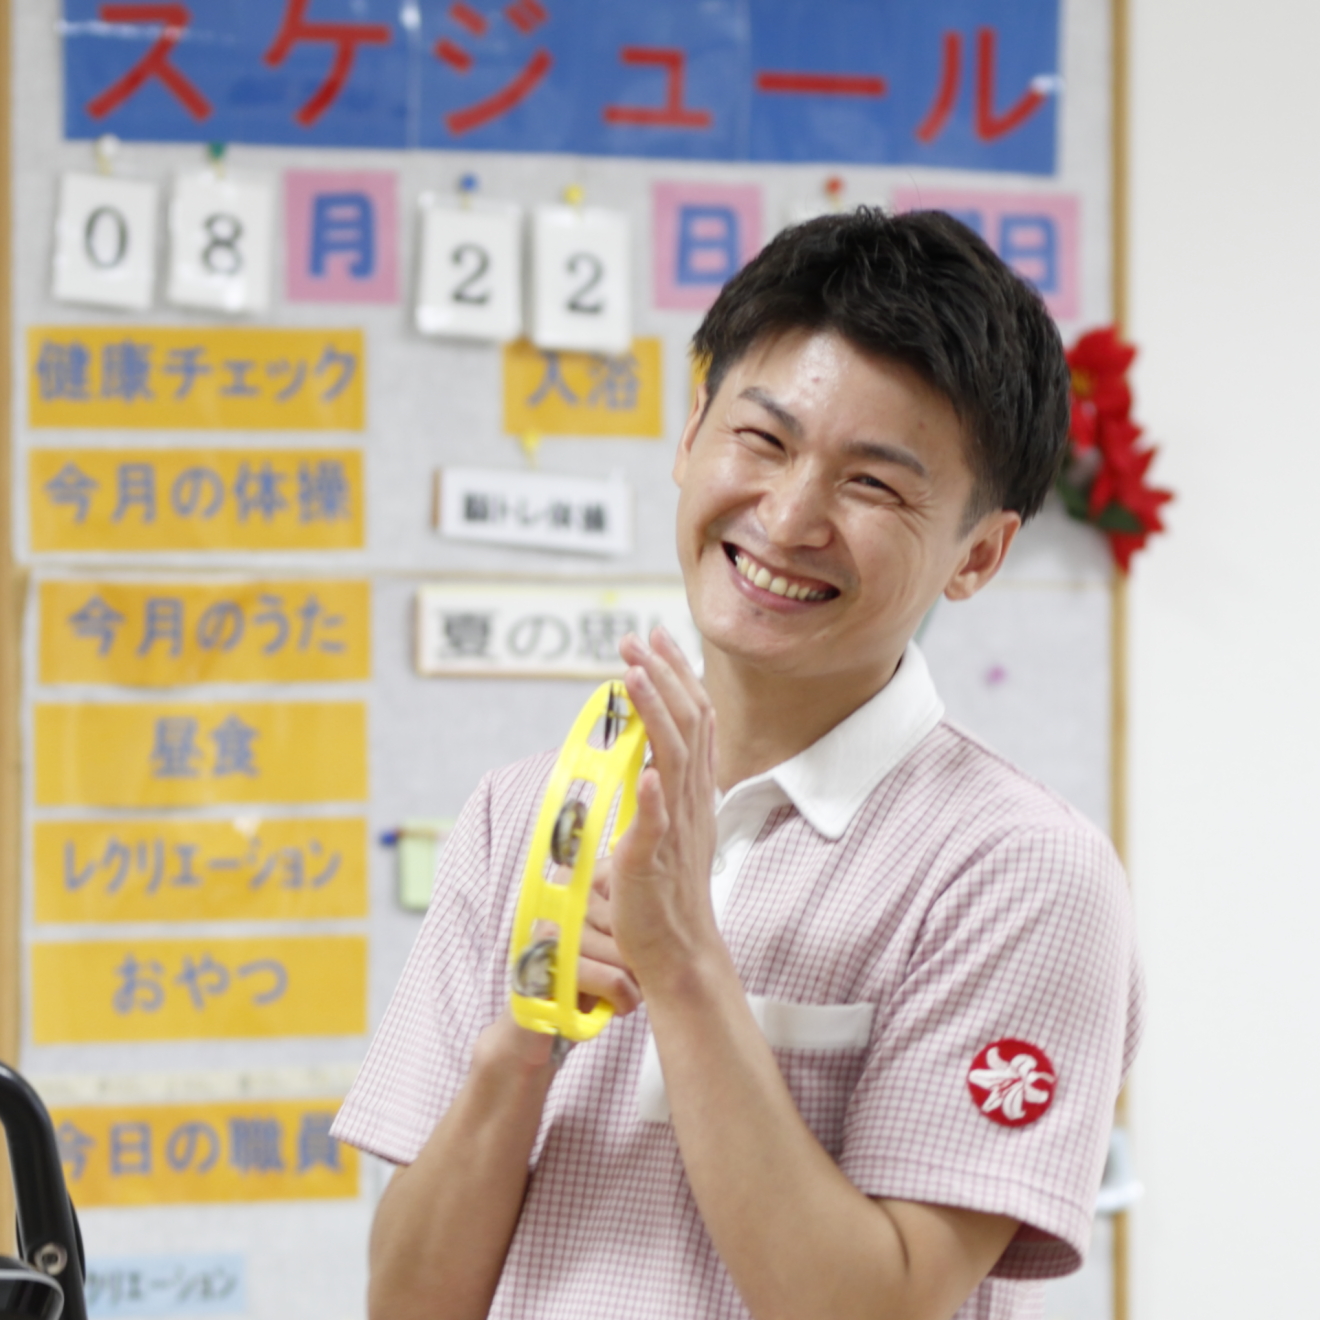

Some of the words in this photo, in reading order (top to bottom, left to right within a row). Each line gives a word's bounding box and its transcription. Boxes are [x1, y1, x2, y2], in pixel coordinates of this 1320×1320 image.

[86, 0, 1051, 142] スケジュール
[36, 339, 358, 403] 健康チェック
[43, 460, 350, 525] 今月の体操
[67, 594, 346, 658] 今月のうた
[436, 609, 663, 661] 夏の思
[150, 713, 261, 778] 昼食
[62, 835, 342, 894] レクリエーション
[112, 952, 289, 1016] おやつ
[55, 1111, 343, 1182] 今日の職員
